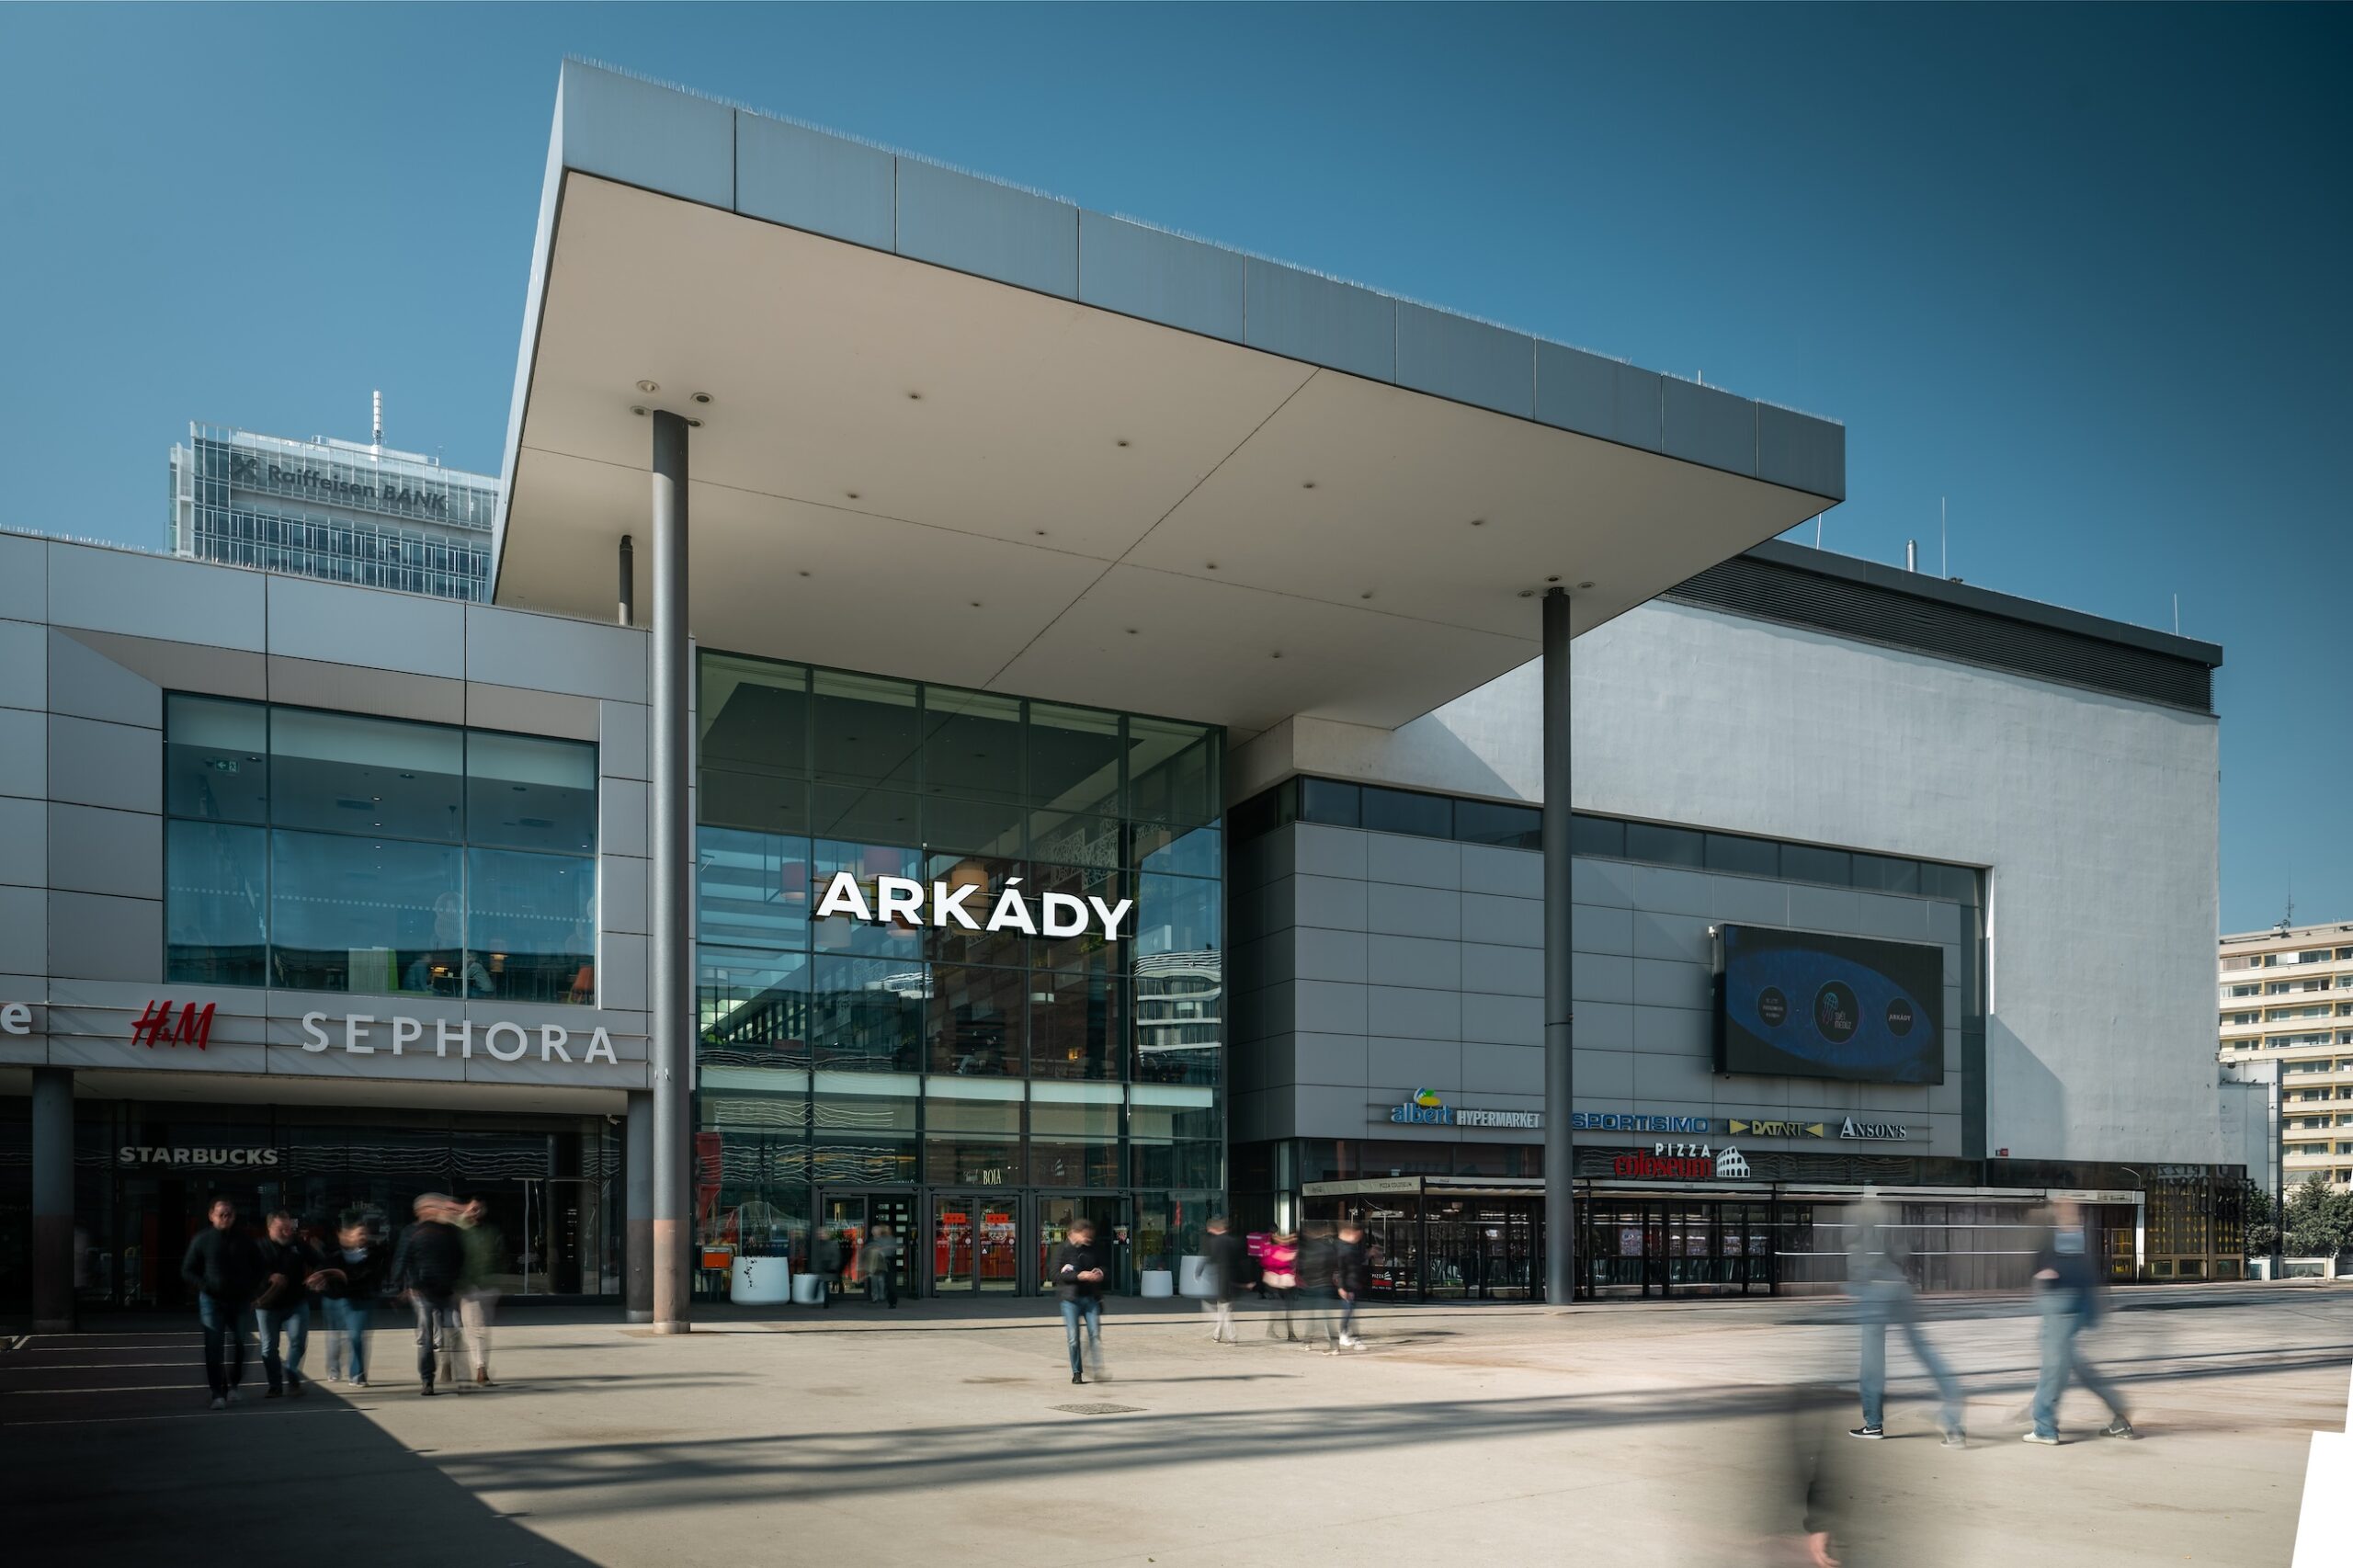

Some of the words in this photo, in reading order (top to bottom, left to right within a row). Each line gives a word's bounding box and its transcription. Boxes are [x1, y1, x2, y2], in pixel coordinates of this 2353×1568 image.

[267, 463, 375, 498] Raiffeisen
[382, 483, 448, 511] BANK
[815, 870, 1134, 941] ARKÁDY
[131, 999, 216, 1051] H&M
[301, 1011, 619, 1065] SEPHORA
[1391, 1102, 1454, 1125] albert
[1456, 1108, 1540, 1129] HYPERMARKET
[1573, 1112, 1710, 1133] SPORTISIMO
[1751, 1119, 1805, 1137] DATART
[119, 1146, 278, 1165] STARBUCKS
[1614, 1149, 1712, 1177] coloseum
[1655, 1142, 1711, 1158] PIZZA
